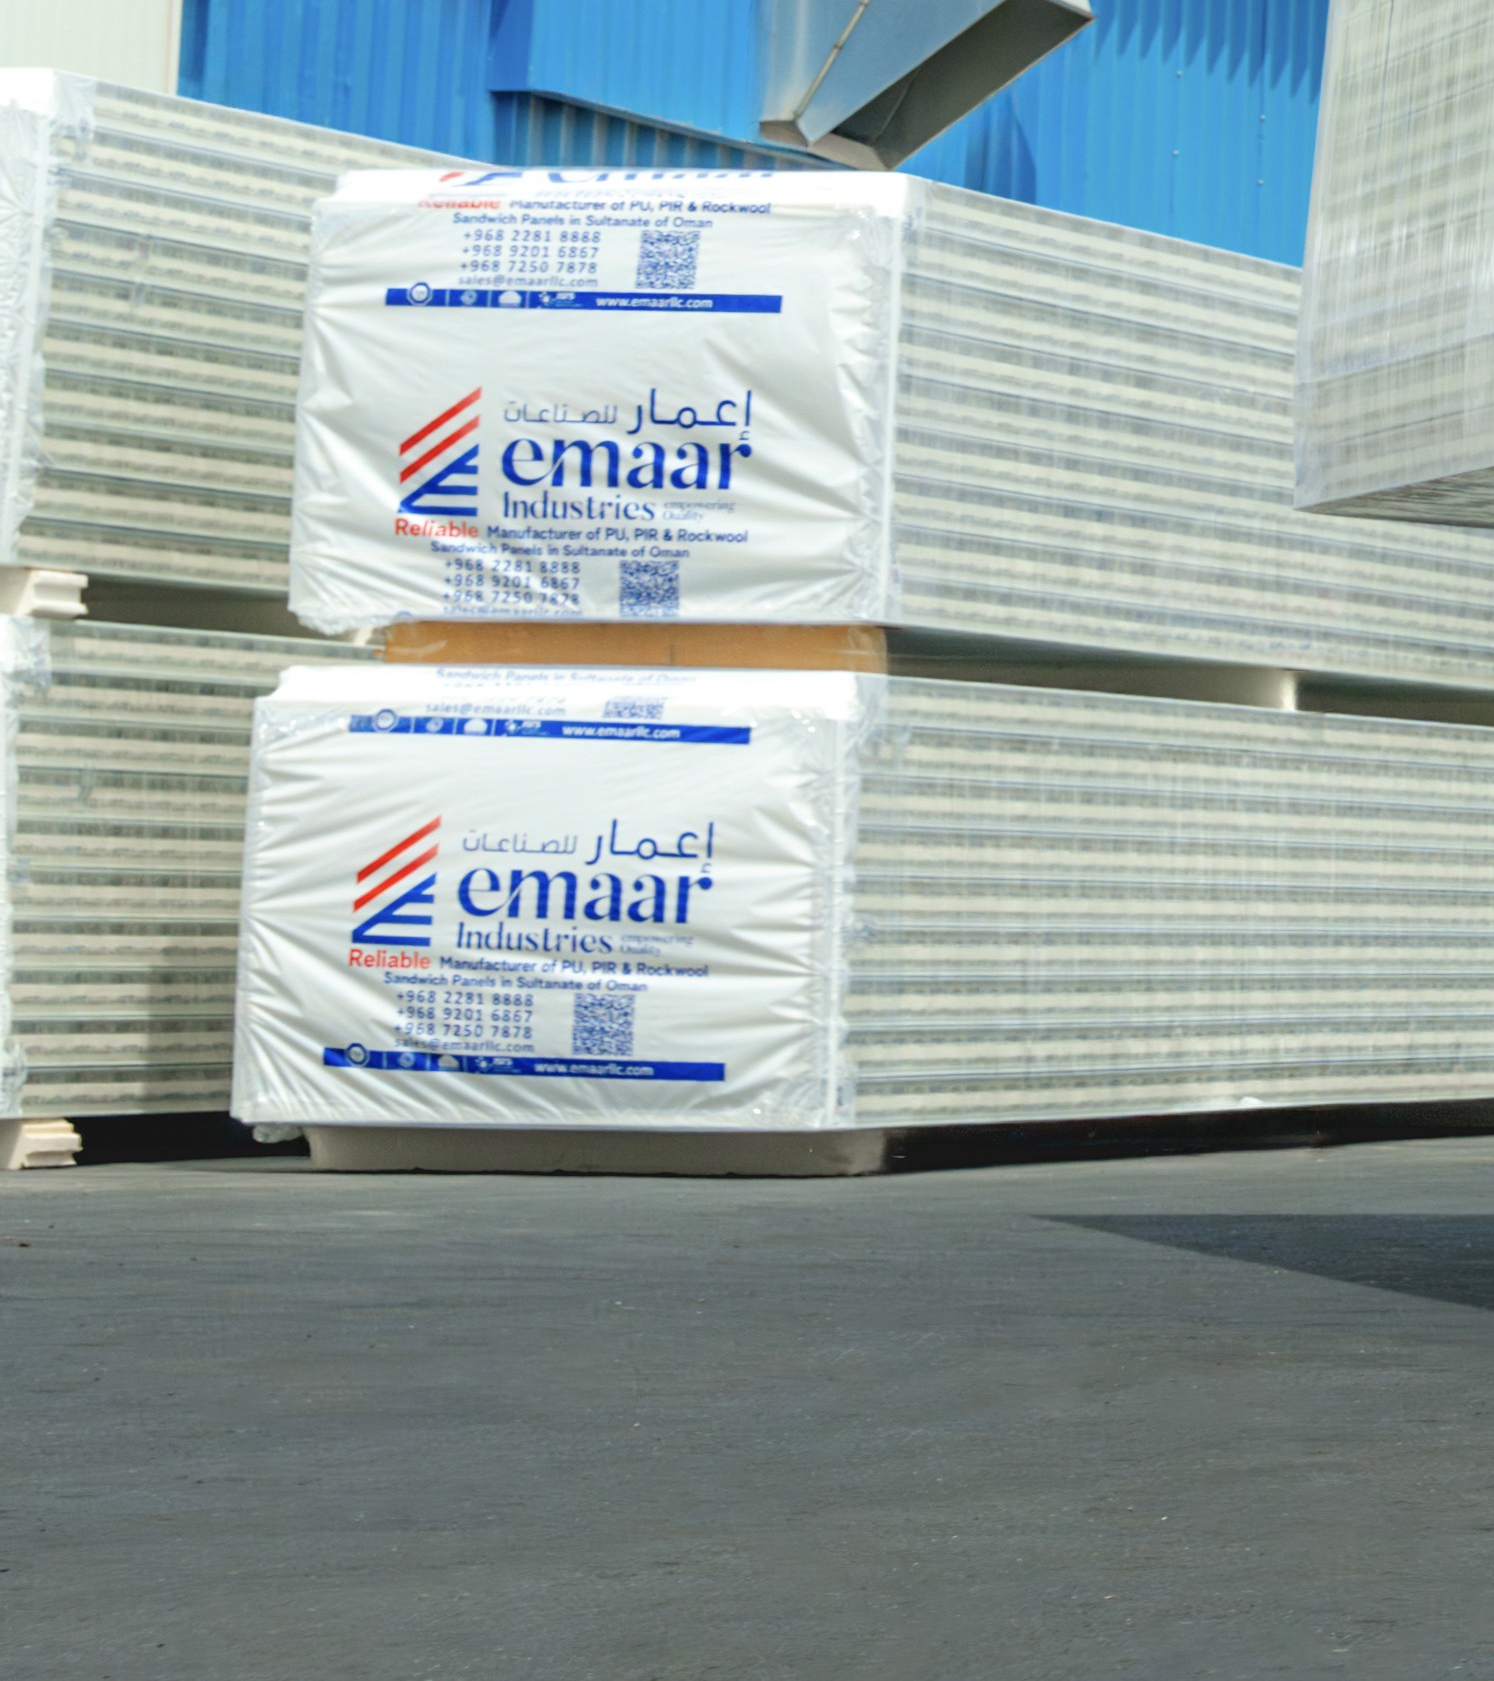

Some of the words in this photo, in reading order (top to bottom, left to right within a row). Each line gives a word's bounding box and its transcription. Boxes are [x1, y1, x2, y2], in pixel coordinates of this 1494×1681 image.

[609, 197, 626, 211] of
[628, 197, 654, 214] PU,
[658, 199, 683, 213] PIR
[686, 198, 698, 213] &
[701, 199, 771, 214] Rockwool
[451, 211, 517, 225] Sandwich
[520, 213, 565, 226] Panels
[568, 214, 581, 226] in
[584, 214, 651, 227] Sultanate
[654, 215, 669, 228] of
[672, 215, 713, 229] Oman
[463, 228, 504, 242] +968
[511, 228, 552, 242] 2281
[559, 230, 601, 244] 8888
[461, 244, 502, 257] +968
[508, 244, 549, 258] 9201
[556, 245, 598, 259] 6867
[459, 259, 501, 273] +968
[508, 259, 549, 273] 7250
[556, 260, 597, 274] 7878
[595, 296, 712, 308] www.emaarllc.com
[503, 400, 617, 424] للصناعات
[625, 387, 751, 441] إعمار
[500, 437, 753, 490] emaar
[502, 489, 655, 522] Industries
[394, 518, 478, 539] Reliable
[486, 524, 583, 540] Manufacturer
[585, 526, 601, 541] of
[604, 527, 629, 544] PU,
[633, 527, 659, 542] PIR
[662, 527, 673, 541] &
[676, 527, 747, 543] Rockwool
[461, 829, 576, 854] للصناعات
[584, 817, 712, 873] إعمار
[455, 867, 711, 924] emaar
[456, 920, 612, 955] Industries
[346, 948, 432, 970] Reliable
[438, 955, 537, 973] Manufacturer
[540, 959, 557, 973] of
[561, 958, 586, 976] PU,
[591, 959, 617, 975] PIR
[620, 959, 632, 974] &
[636, 960, 708, 977] Rockwool
